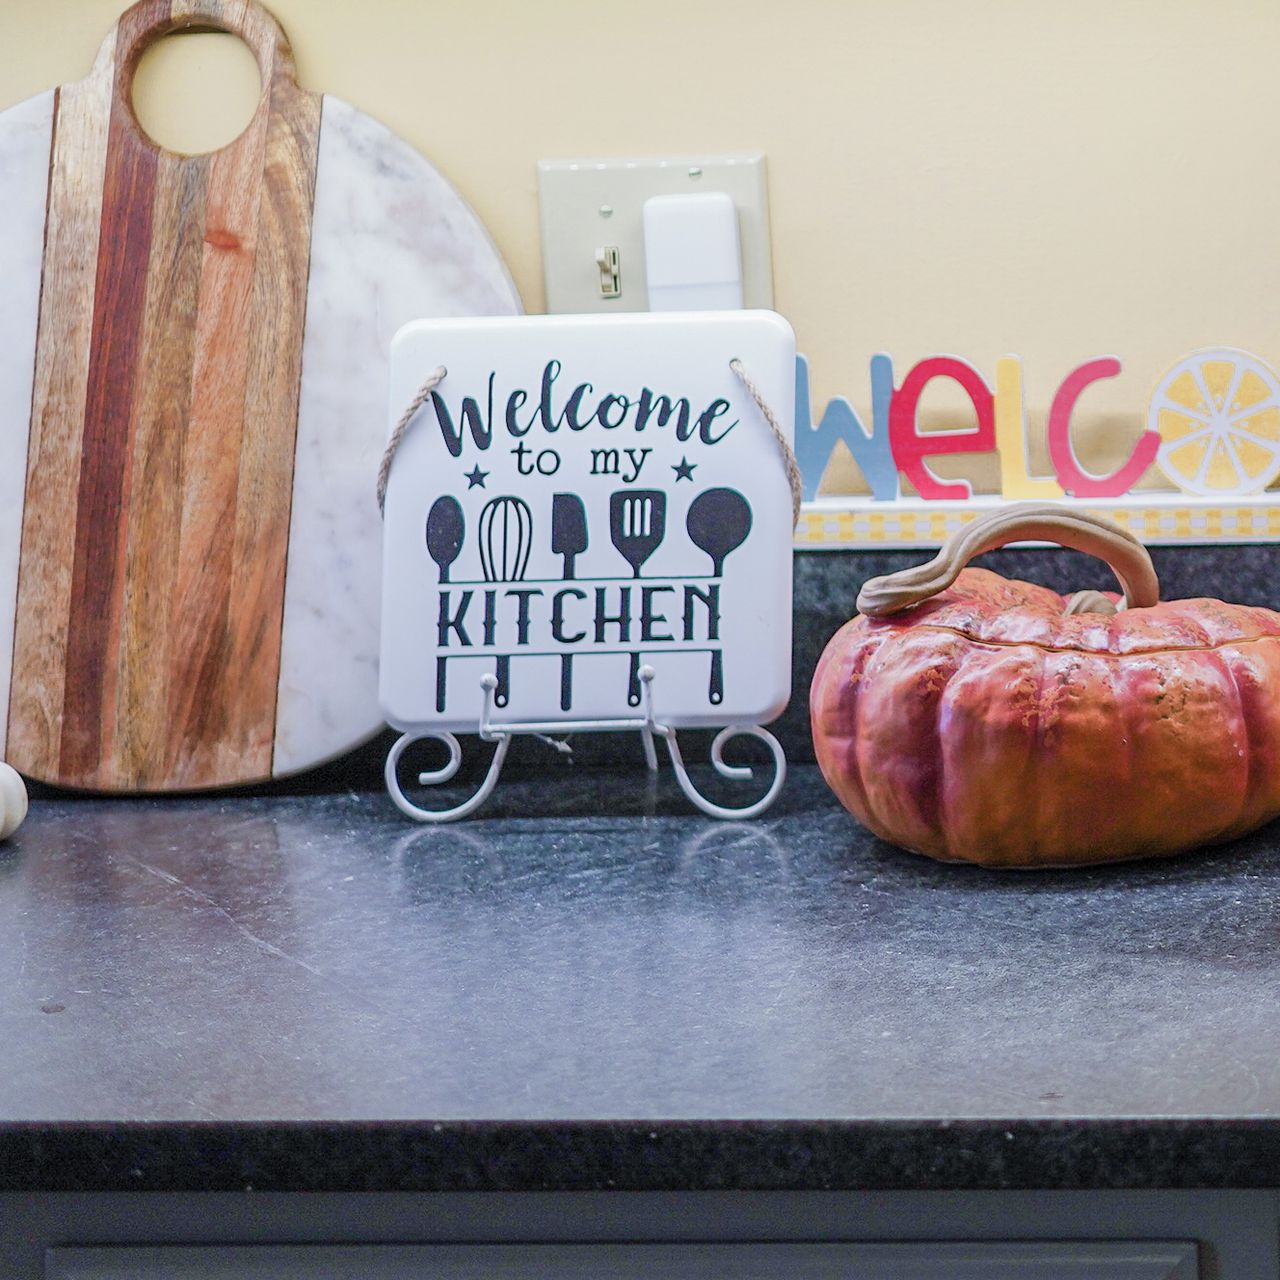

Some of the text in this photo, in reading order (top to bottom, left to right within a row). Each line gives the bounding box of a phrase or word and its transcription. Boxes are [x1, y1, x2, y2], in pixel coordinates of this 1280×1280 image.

[430, 359, 740, 458] Welcome
[510, 440, 653, 483] to my
[436, 584, 722, 647] KITCHEN
